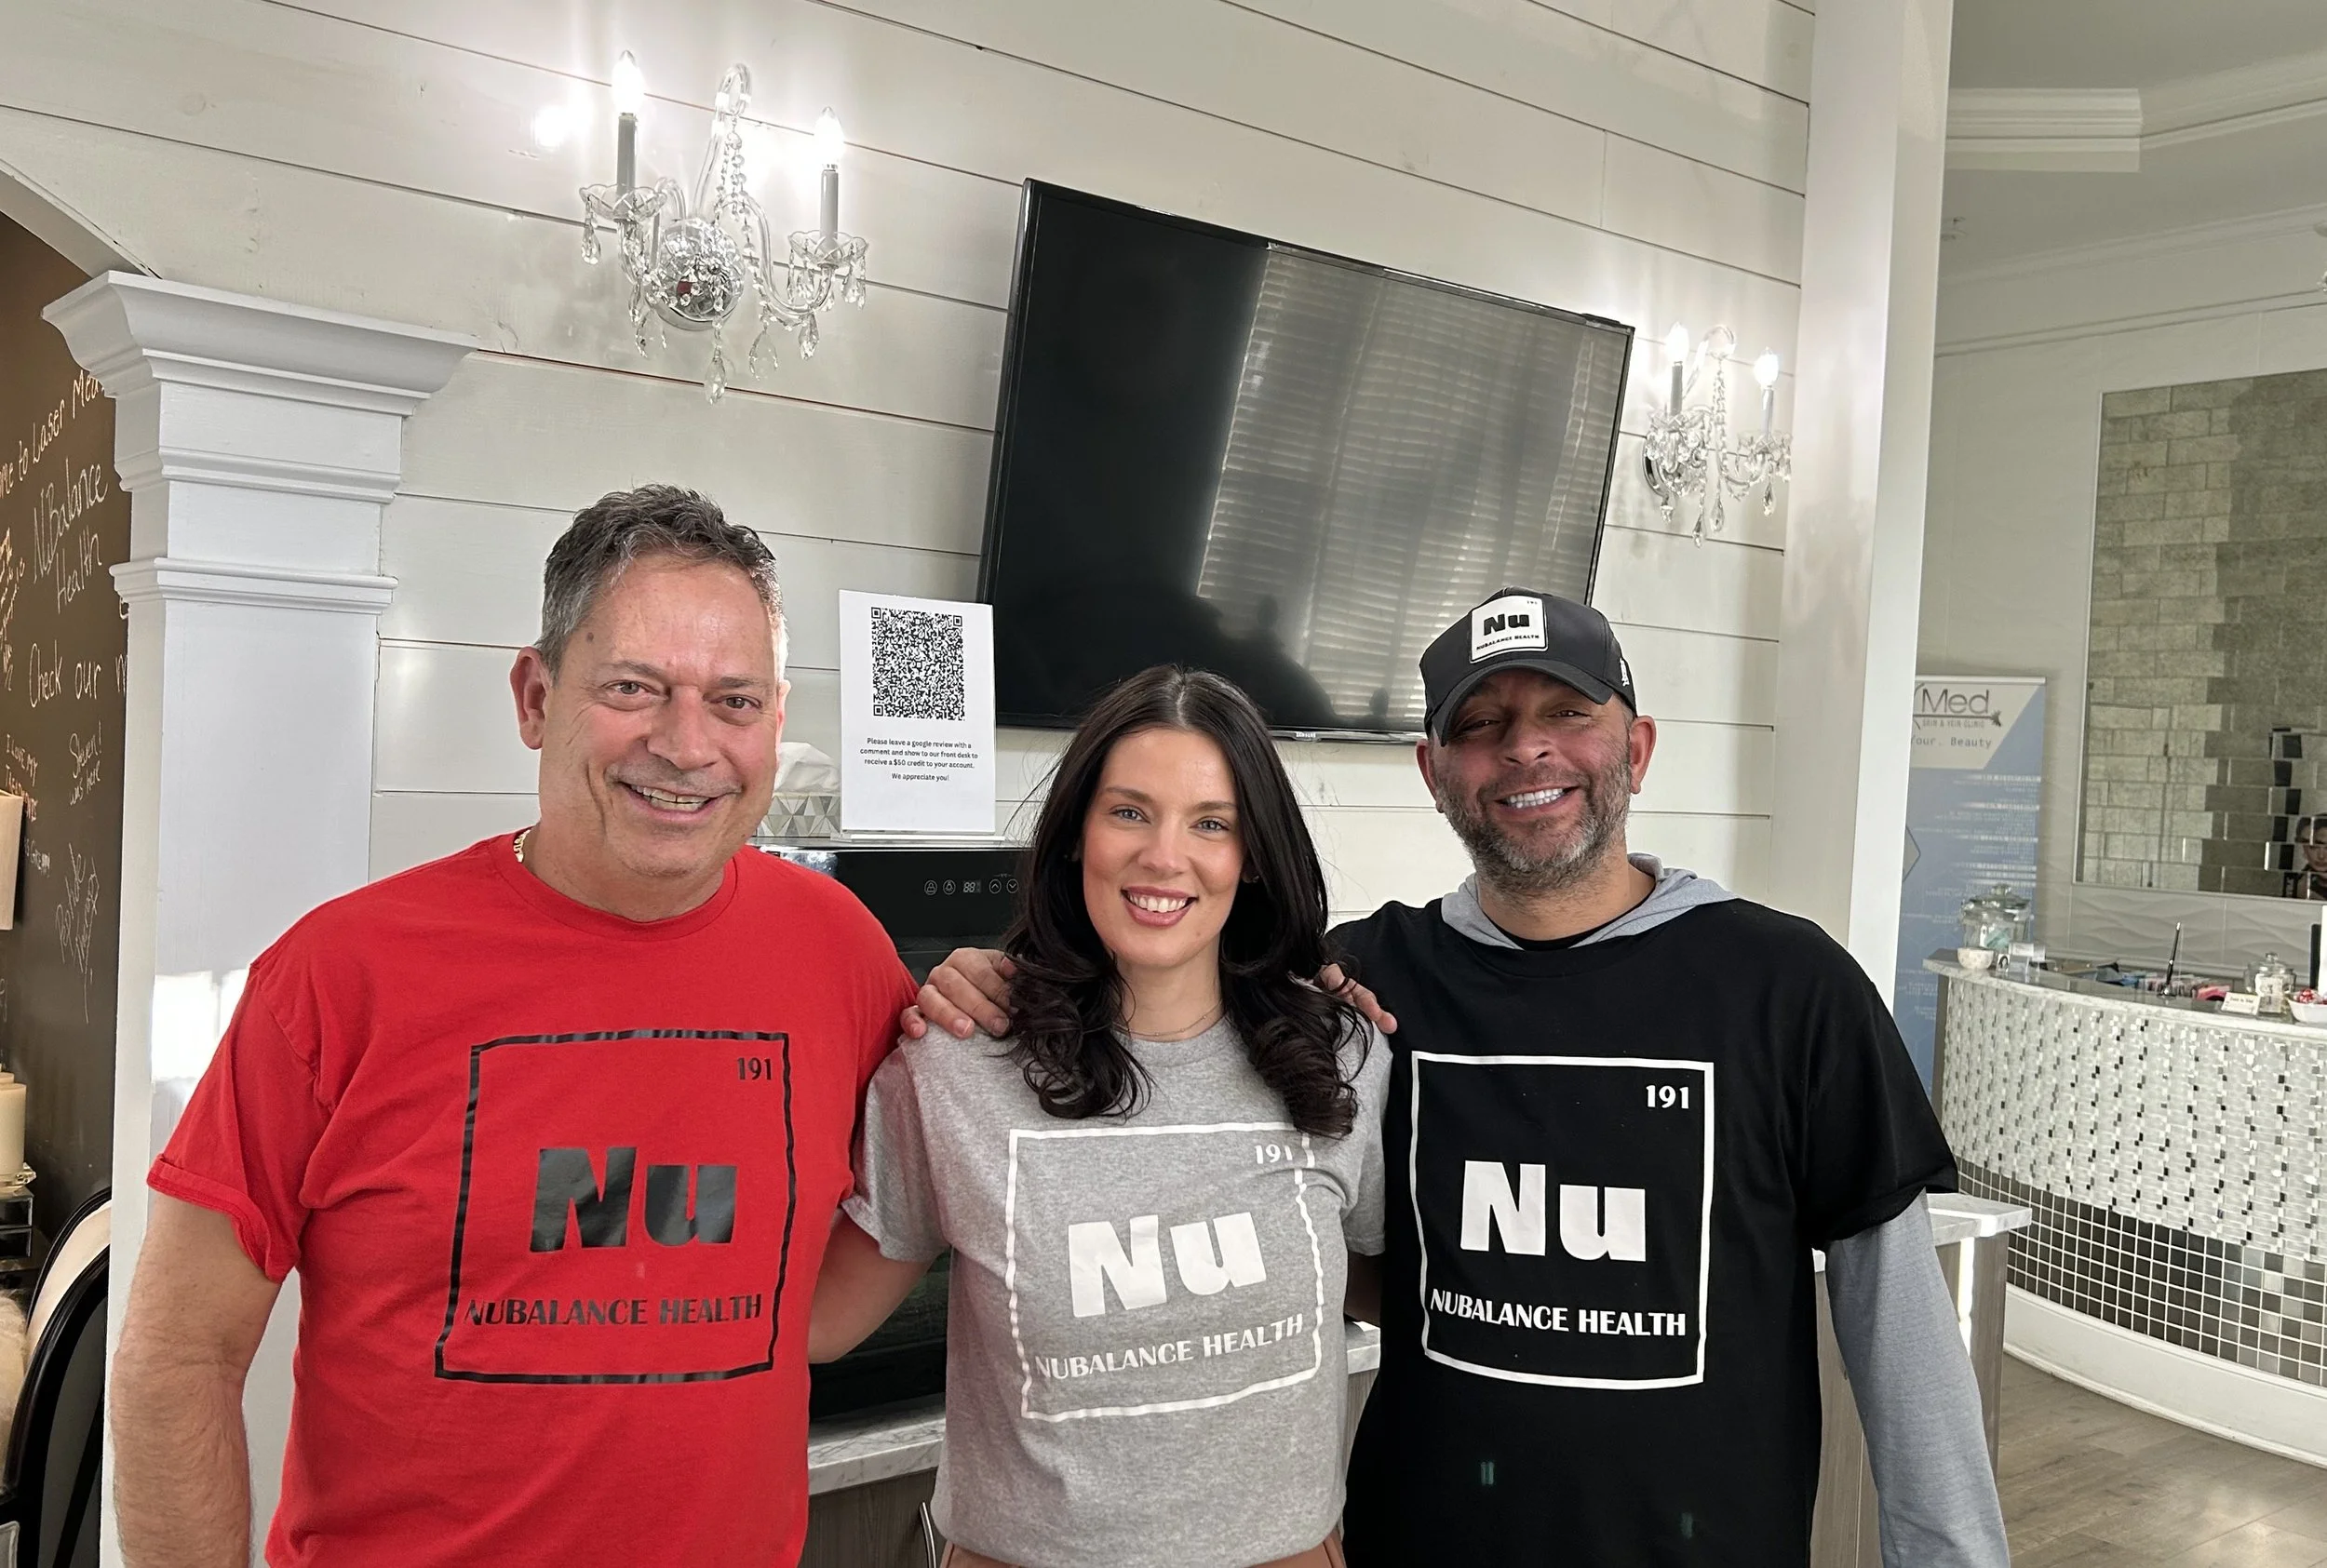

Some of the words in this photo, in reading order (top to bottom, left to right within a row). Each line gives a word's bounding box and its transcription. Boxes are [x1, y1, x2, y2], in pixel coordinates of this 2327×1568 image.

[19, 439, 28, 482] to
[34, 398, 64, 463] Laser
[56, 525, 102, 615] Health
[1483, 613, 1530, 637] Nu
[1475, 636, 1513, 650] NUBALANCE
[30, 639, 62, 707] Check
[74, 662, 101, 700] our
[1921, 689, 1990, 715] Med
[867, 737, 888, 745] Please
[911, 740, 932, 748] google
[904, 748, 921, 757] show
[940, 750, 957, 758] front
[1950, 736, 1992, 748] Beauty
[902, 772, 935, 781] appreciate
[735, 1057, 773, 1081] 191
[1646, 1084, 1690, 1109] 191
[1256, 1144, 1294, 1165] 191
[530, 1146, 738, 1253] Nu
[1459, 1159, 1647, 1263] Nu
[1068, 1211, 1268, 1319] Nu
[464, 1297, 649, 1326] NUBALANCE
[658, 1293, 762, 1324] HEALTH
[1430, 1287, 1570, 1333] NUBALANCE
[1578, 1308, 1687, 1337] HEALTH
[1034, 1339, 1194, 1381] NUBALANCE
[1203, 1312, 1303, 1358] HEALTH
